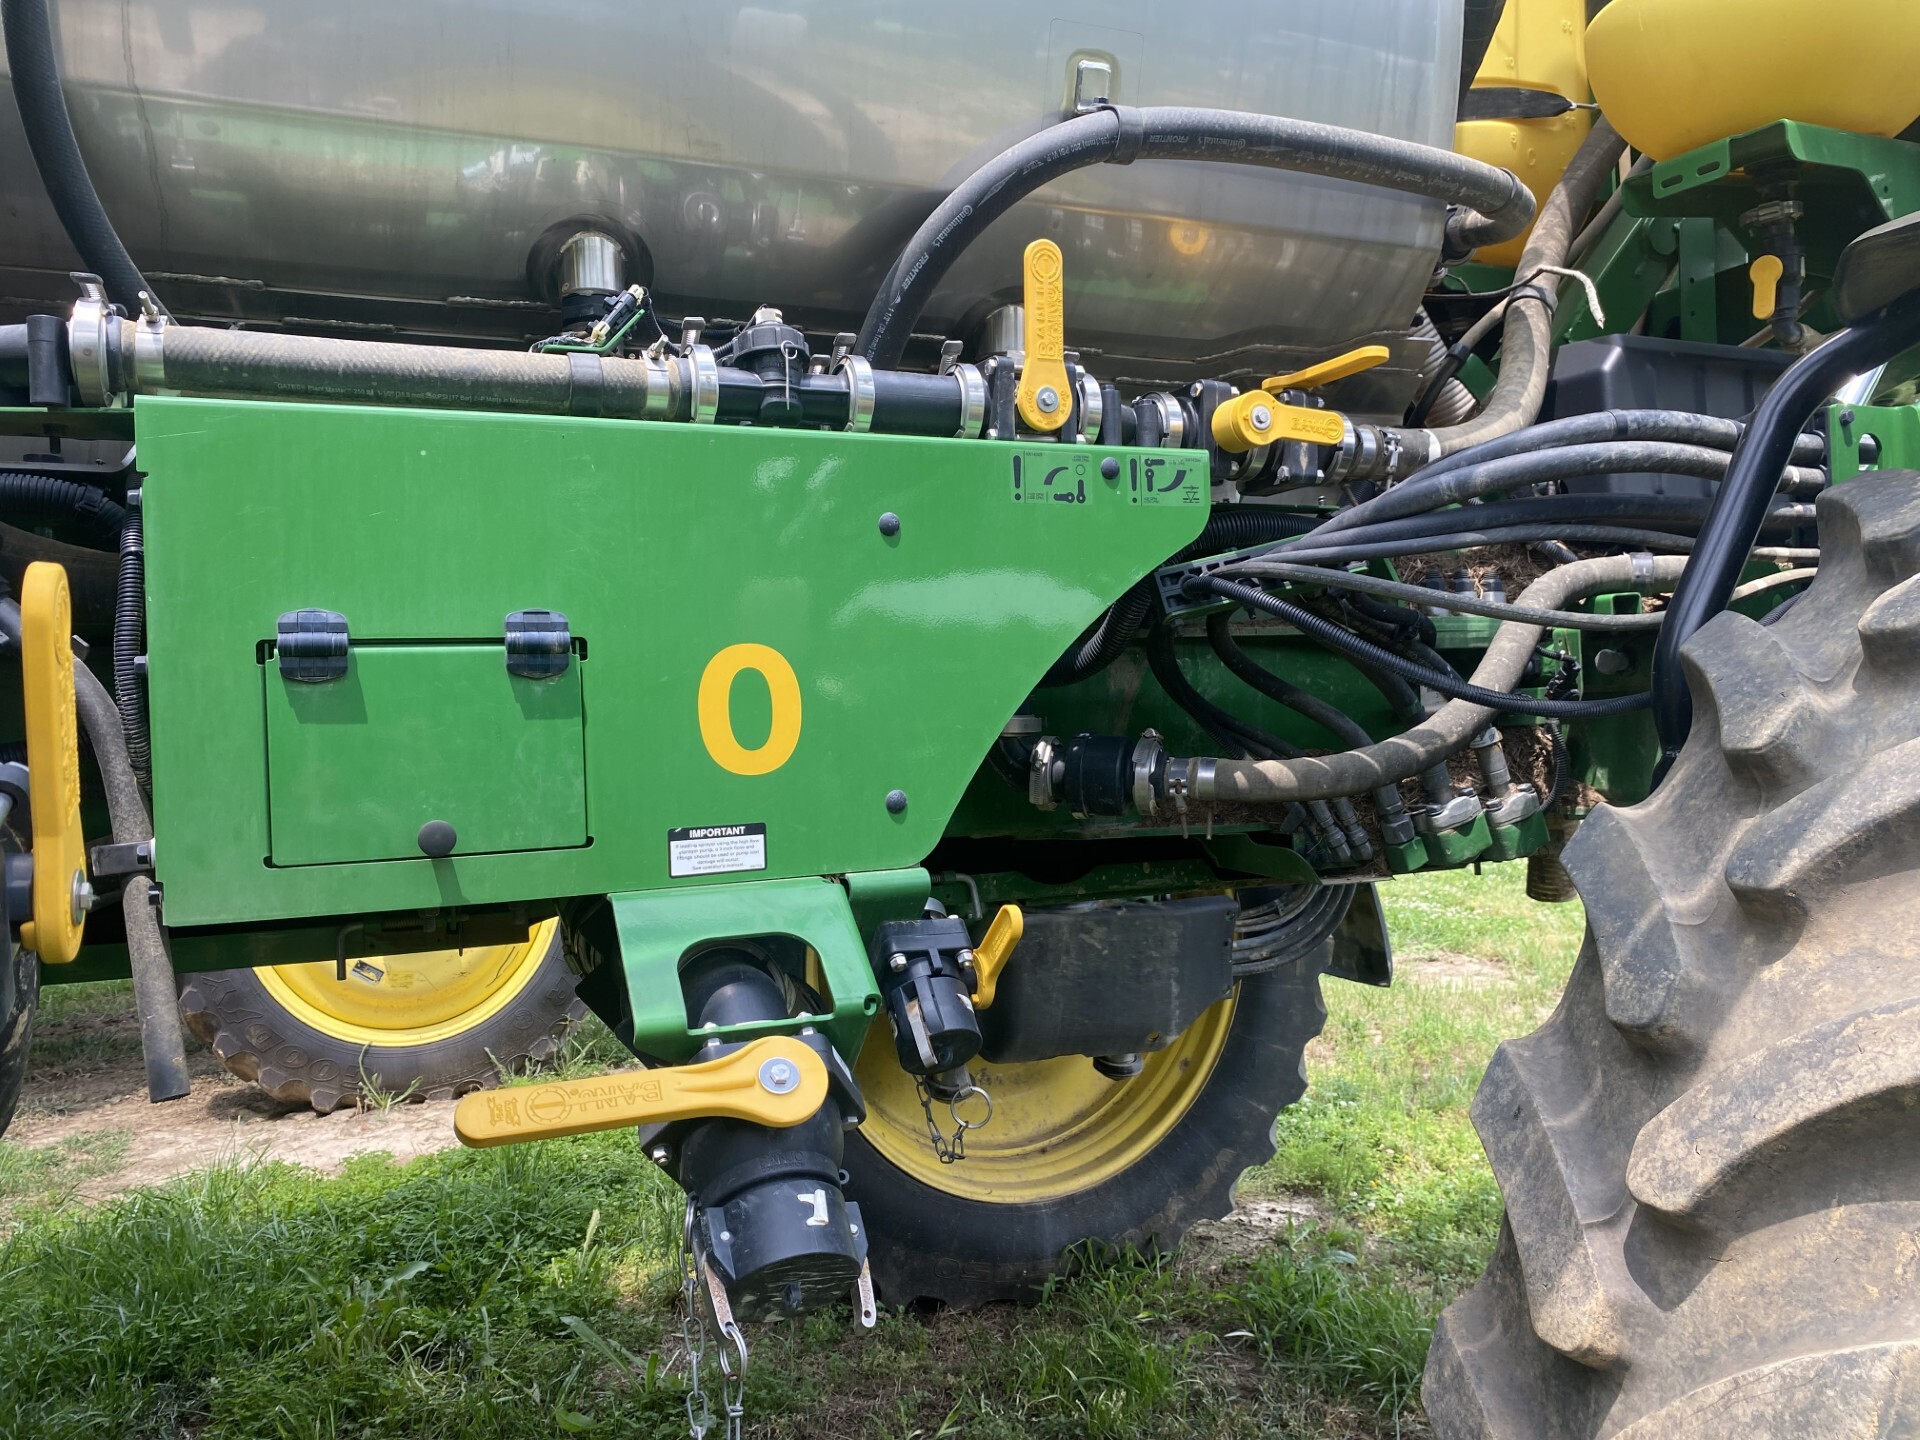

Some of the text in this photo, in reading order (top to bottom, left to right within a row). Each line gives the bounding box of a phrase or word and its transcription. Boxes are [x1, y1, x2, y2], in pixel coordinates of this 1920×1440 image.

[1149, 134, 1190, 144] FRONTIER
[901, 204, 973, 290] Continental FRONTIER
[689, 826, 746, 838] IMPORTANT
